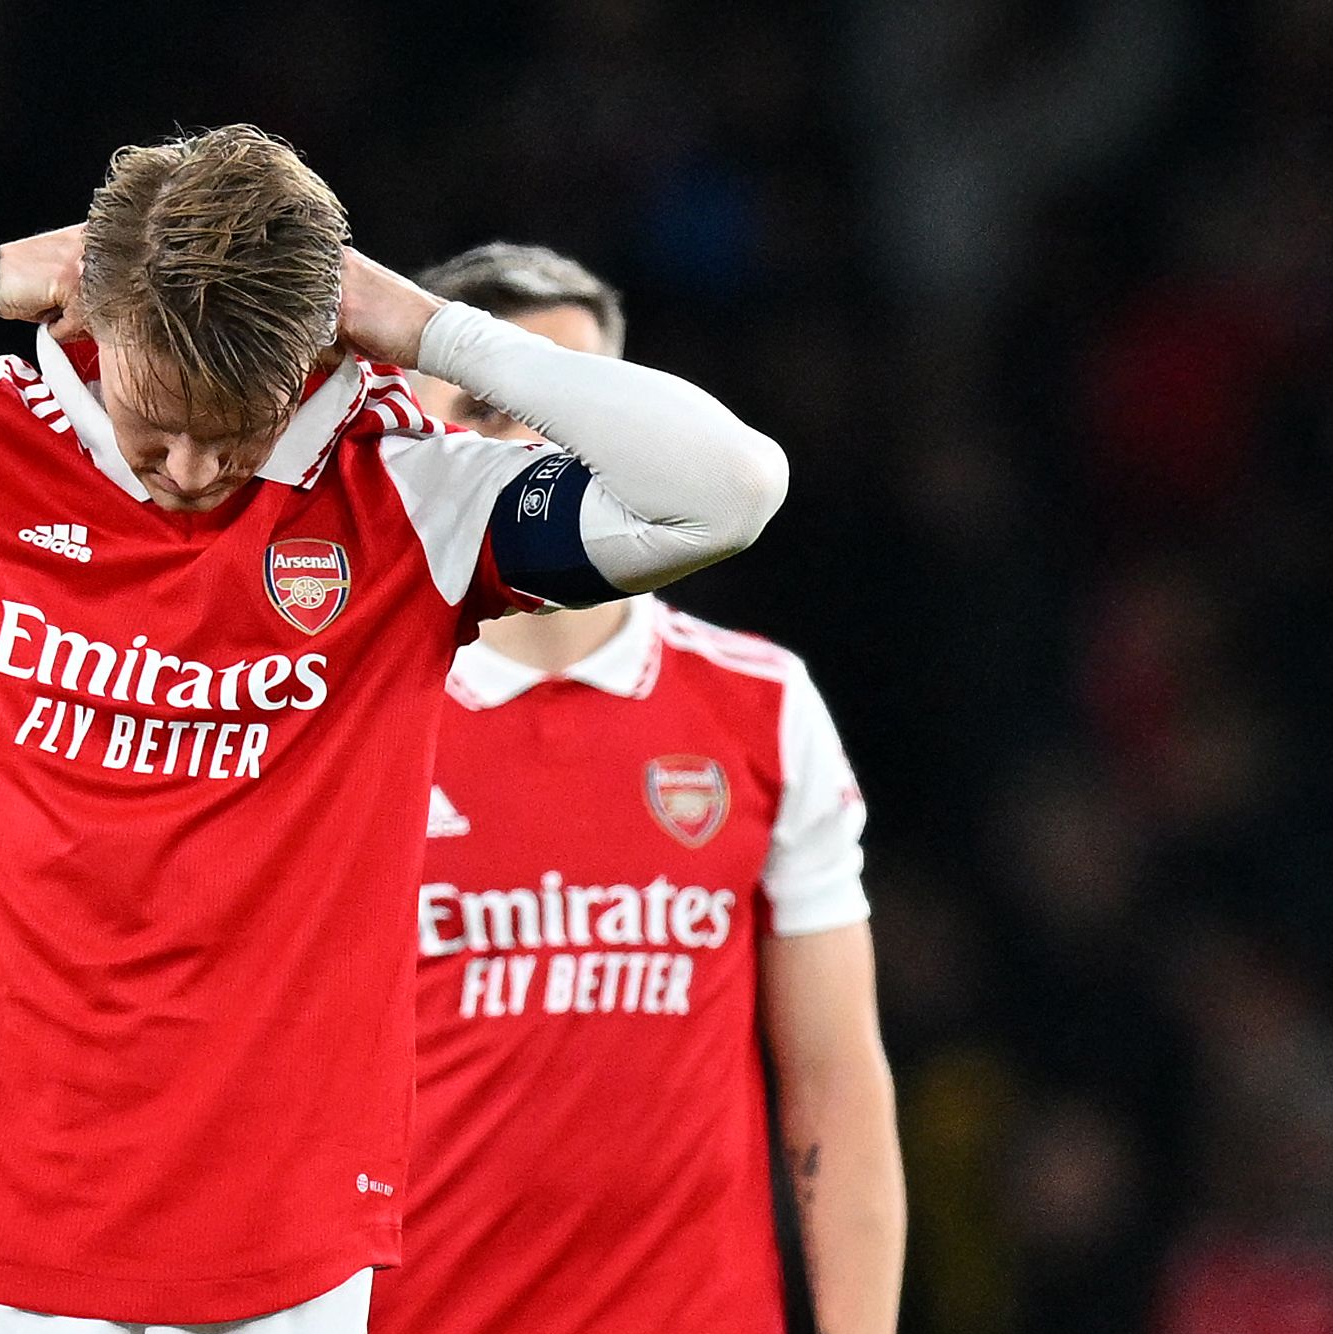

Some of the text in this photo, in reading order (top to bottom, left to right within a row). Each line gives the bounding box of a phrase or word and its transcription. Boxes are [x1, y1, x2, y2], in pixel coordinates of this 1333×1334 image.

[18, 528, 93, 563] adidas
[274, 553, 337, 569] Arsenal
[14, 696, 271, 779] FLY BETTER
[418, 870, 736, 957] Emirates
[459, 951, 695, 1019] FLY BETTER
